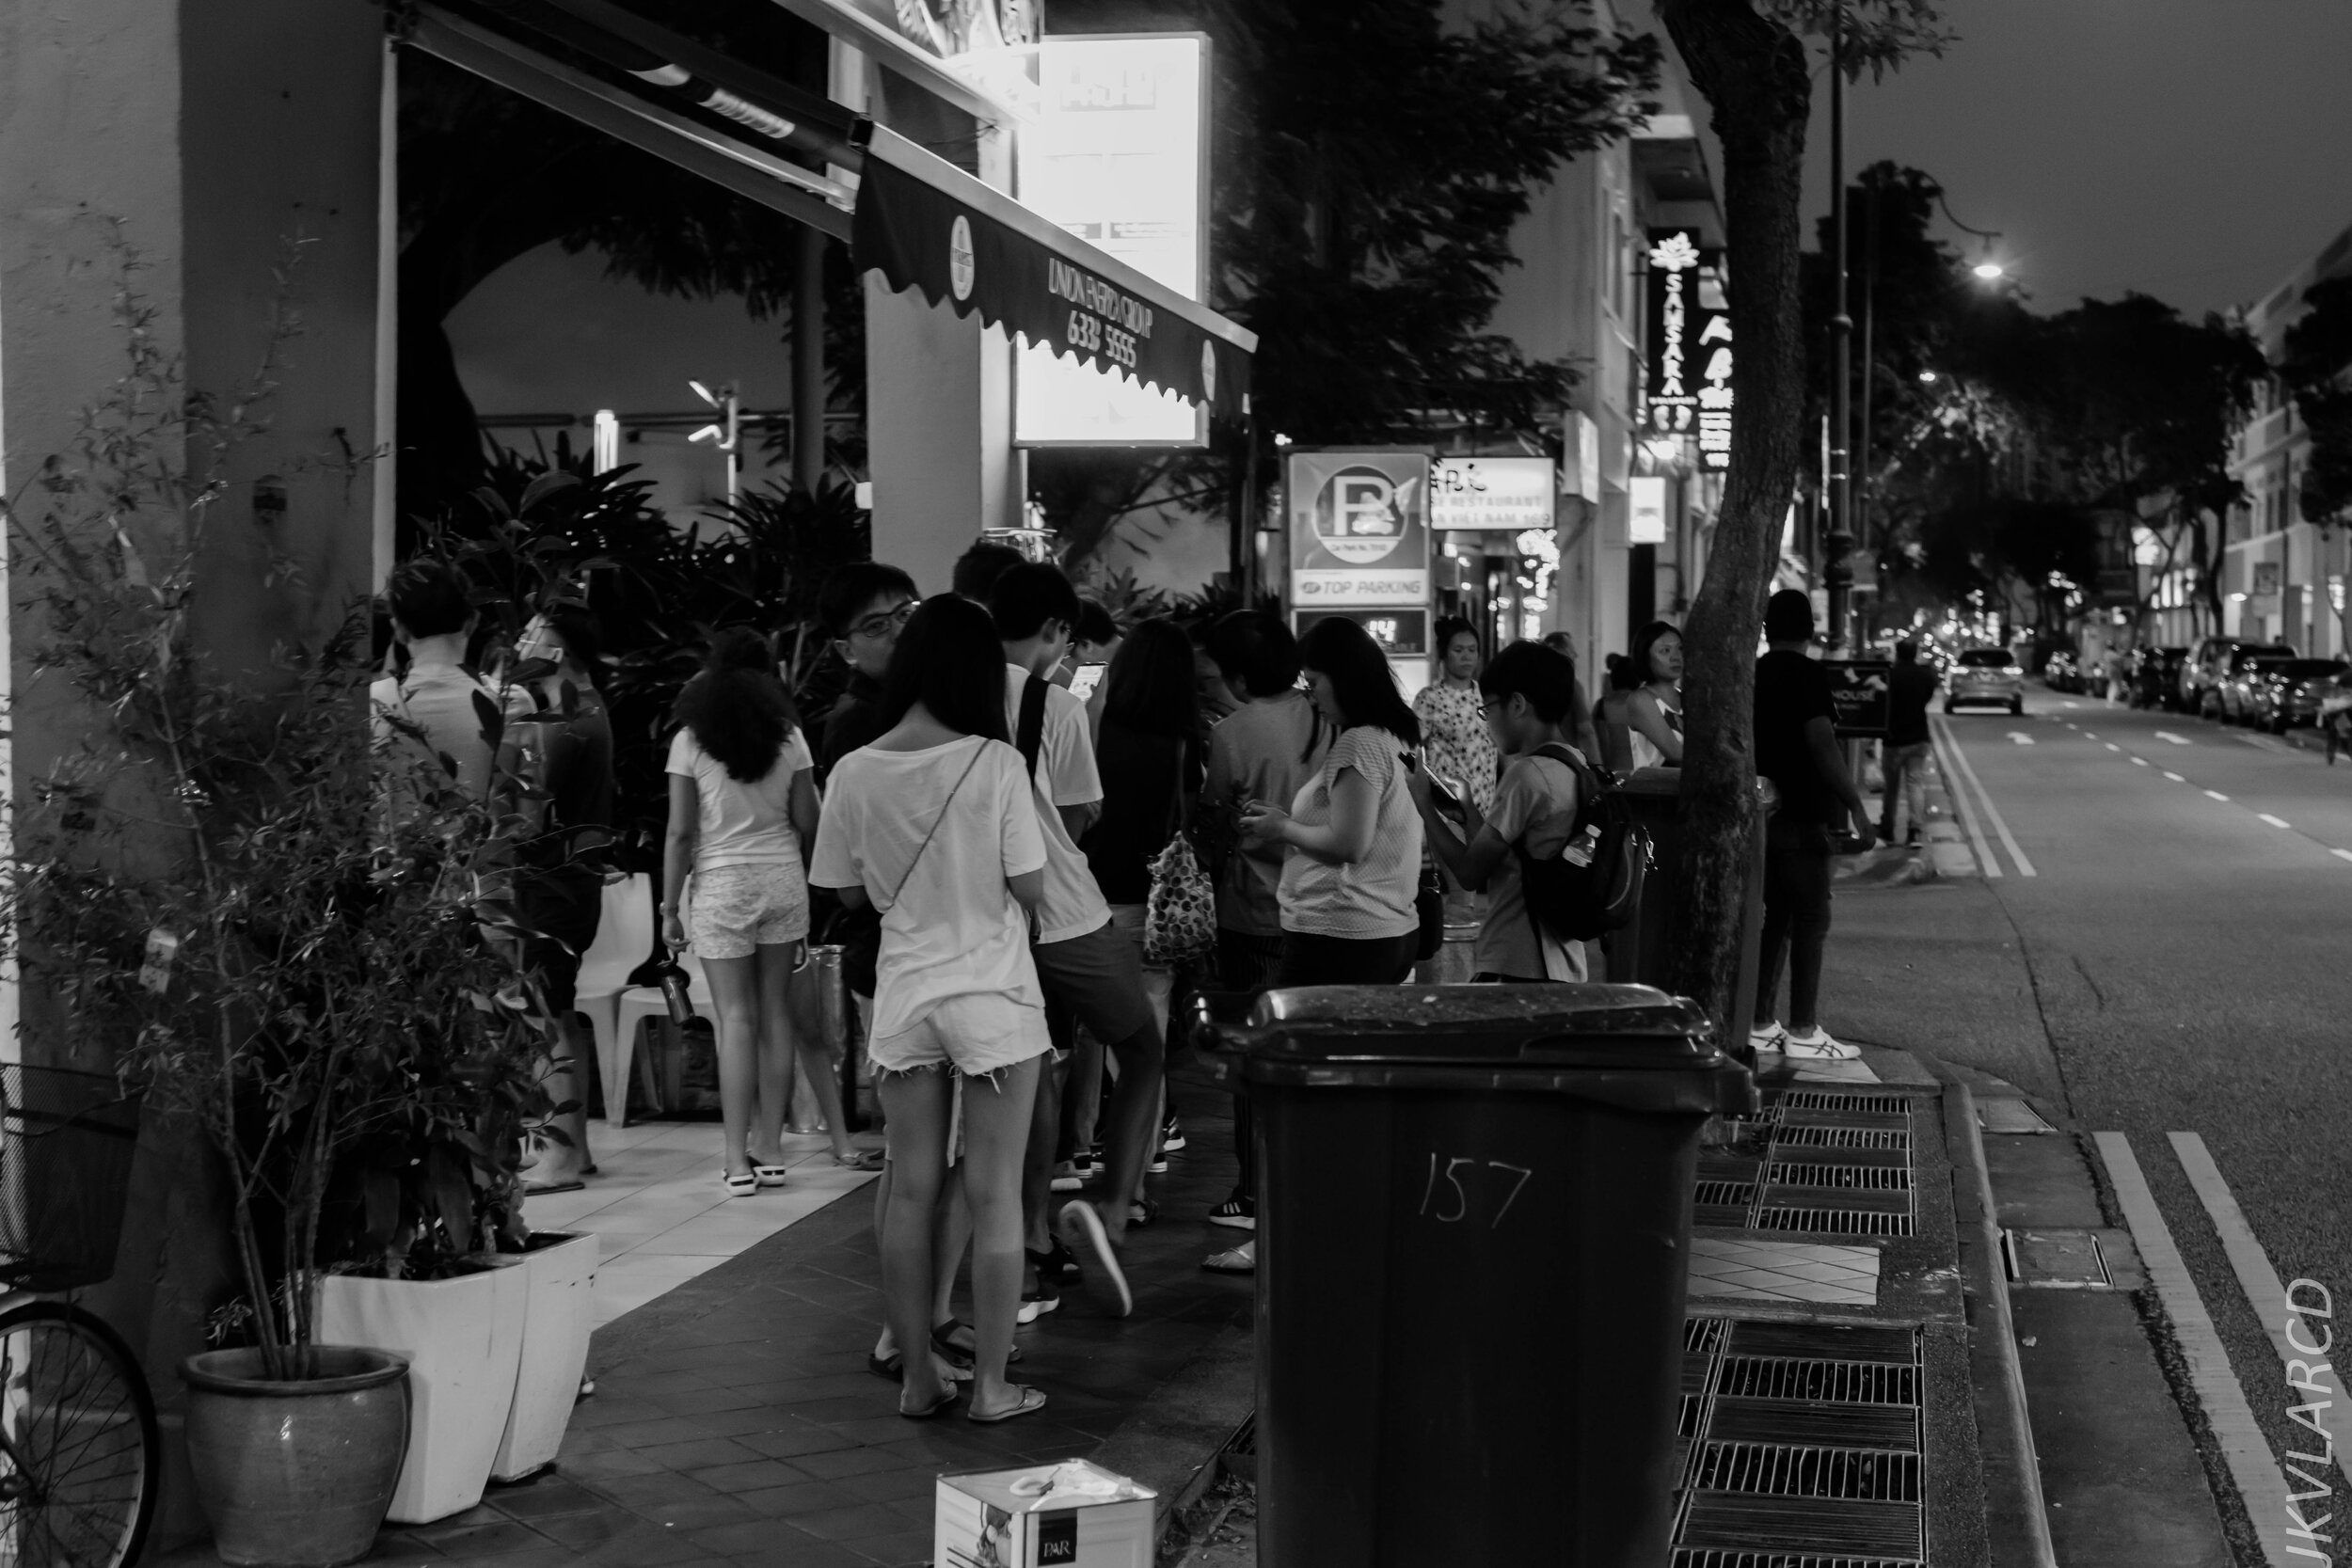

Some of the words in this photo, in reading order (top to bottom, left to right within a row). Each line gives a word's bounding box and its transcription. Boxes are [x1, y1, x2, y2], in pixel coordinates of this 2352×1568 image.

[1450, 496, 1542, 507] RESTAURANT
[1324, 581, 1352, 594] TOP
[1356, 580, 1421, 594] PARKING
[1420, 1152, 1532, 1228] 157
